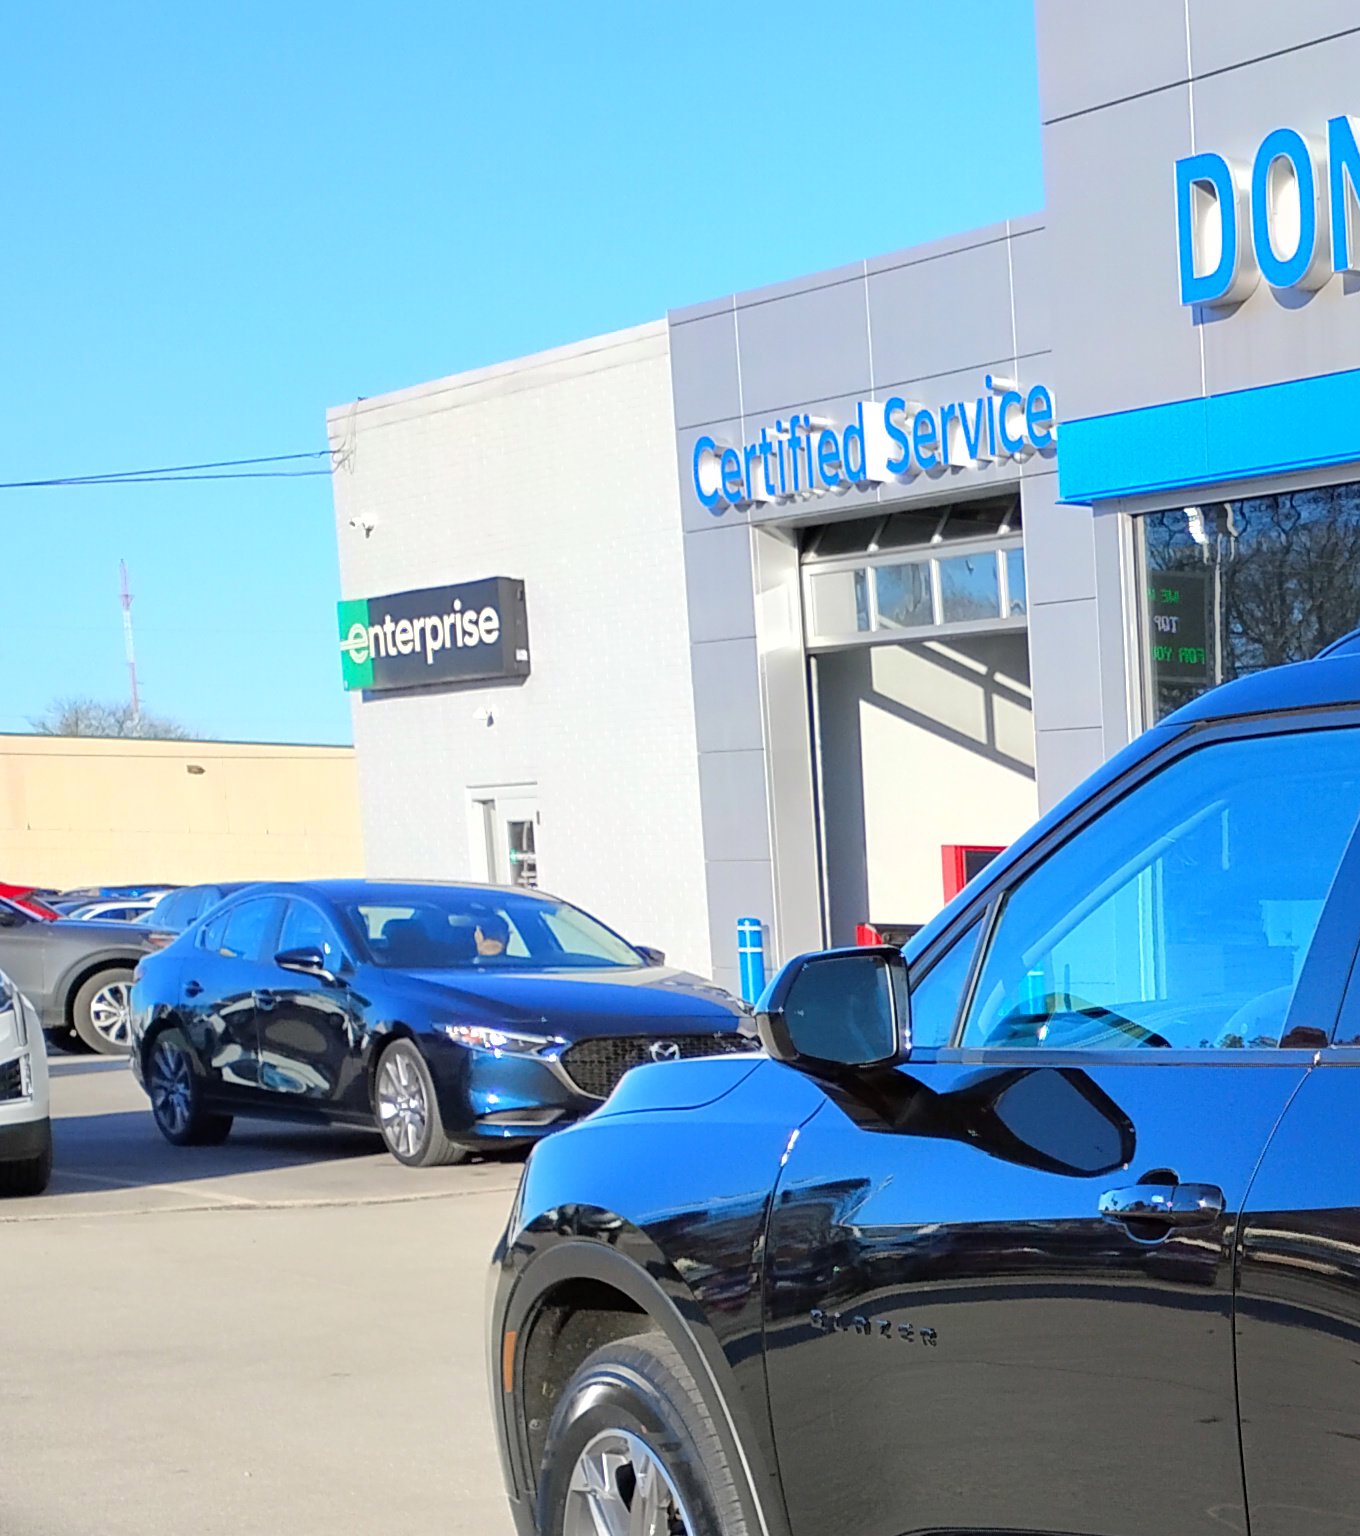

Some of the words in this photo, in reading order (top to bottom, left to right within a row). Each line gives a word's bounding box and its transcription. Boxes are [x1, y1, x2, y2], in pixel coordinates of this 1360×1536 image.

[693, 401, 867, 508] Certified
[884, 374, 1054, 475] Service
[340, 598, 500, 665] enterprise
[809, 1308, 938, 1347] BLAZER
